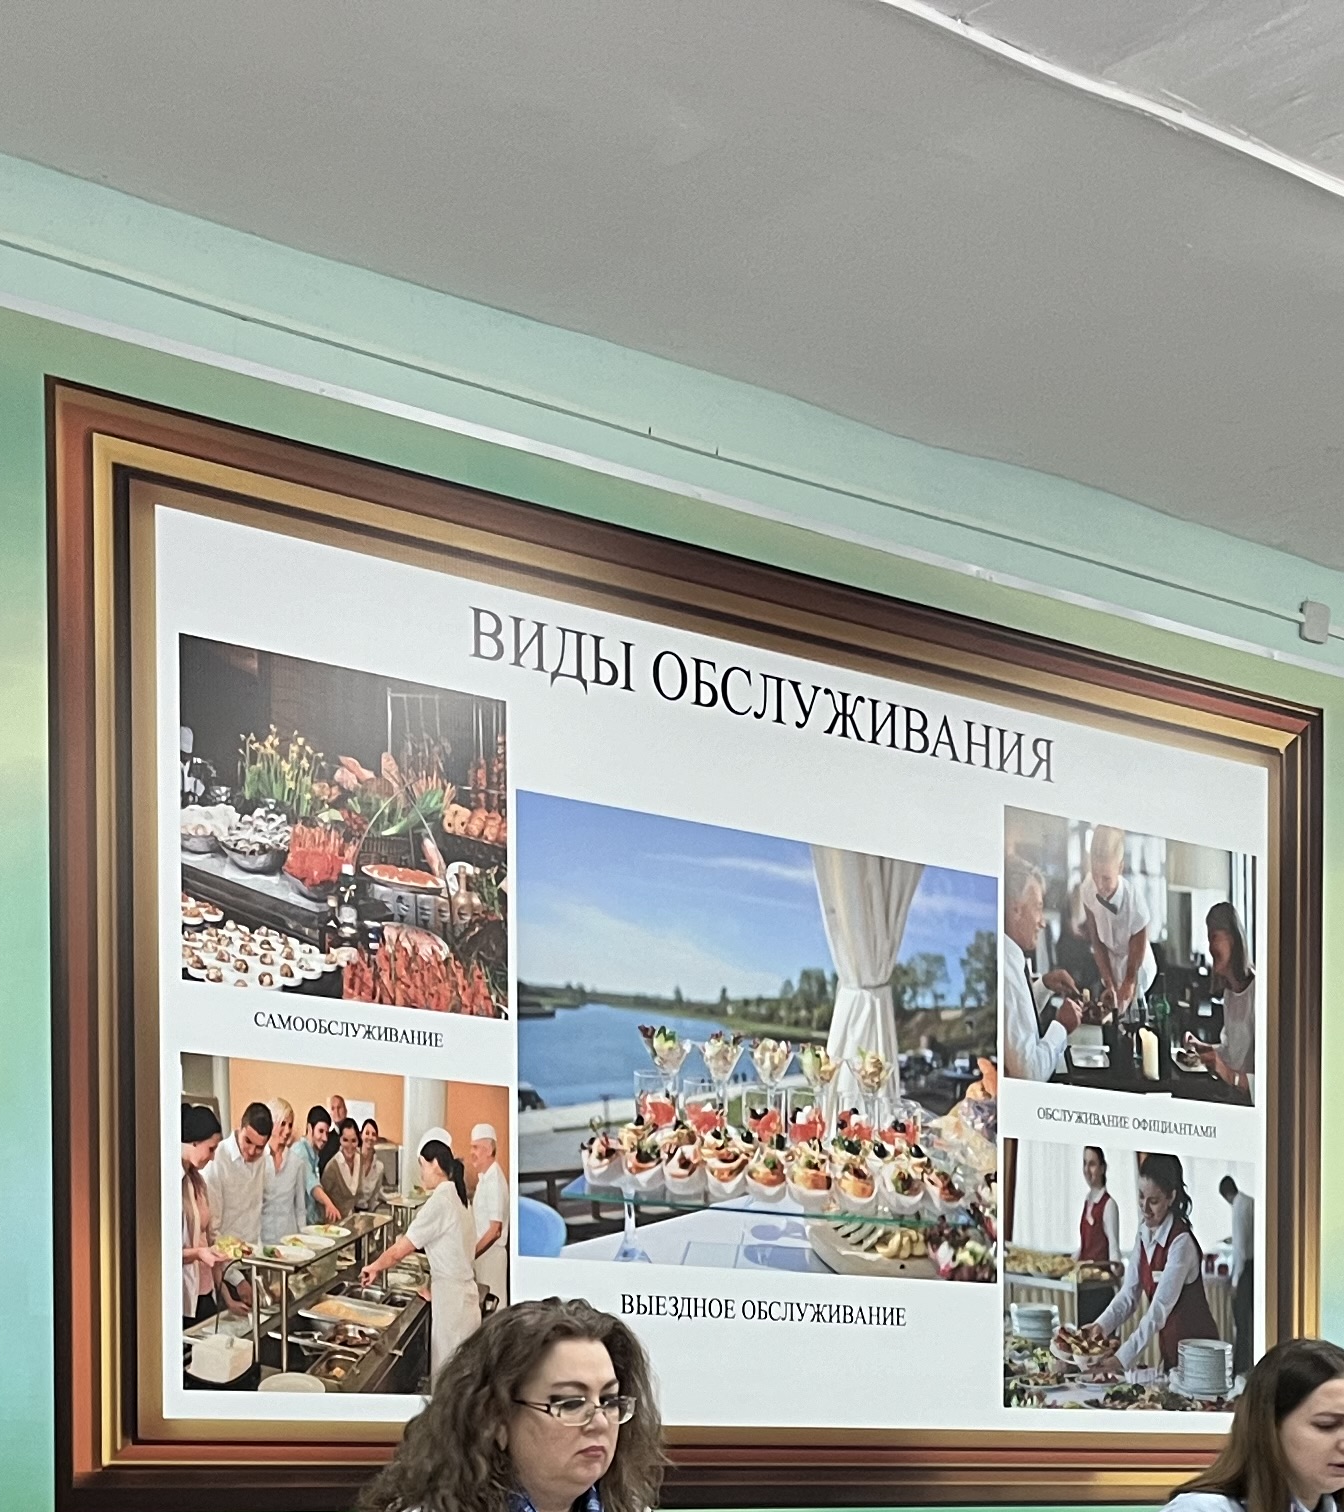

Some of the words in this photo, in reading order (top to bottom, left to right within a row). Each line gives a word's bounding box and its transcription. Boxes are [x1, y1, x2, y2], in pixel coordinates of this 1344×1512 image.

[468, 605, 635, 695] ВИДЫ
[652, 650, 1056, 783] ОБСЛУЖИВАНИЯ
[253, 1011, 444, 1047] САМООБСЛУЖИВАНИЕ
[1037, 1107, 1129, 1129] ОБСЛУЖИВАНИЕ
[1133, 1118, 1218, 1138] ОФИЦИАНТАМИ
[621, 1294, 736, 1320] ВЫЕЗДНОЕ
[742, 1299, 907, 1327] ОБСЛУЖИВАНИЕ
